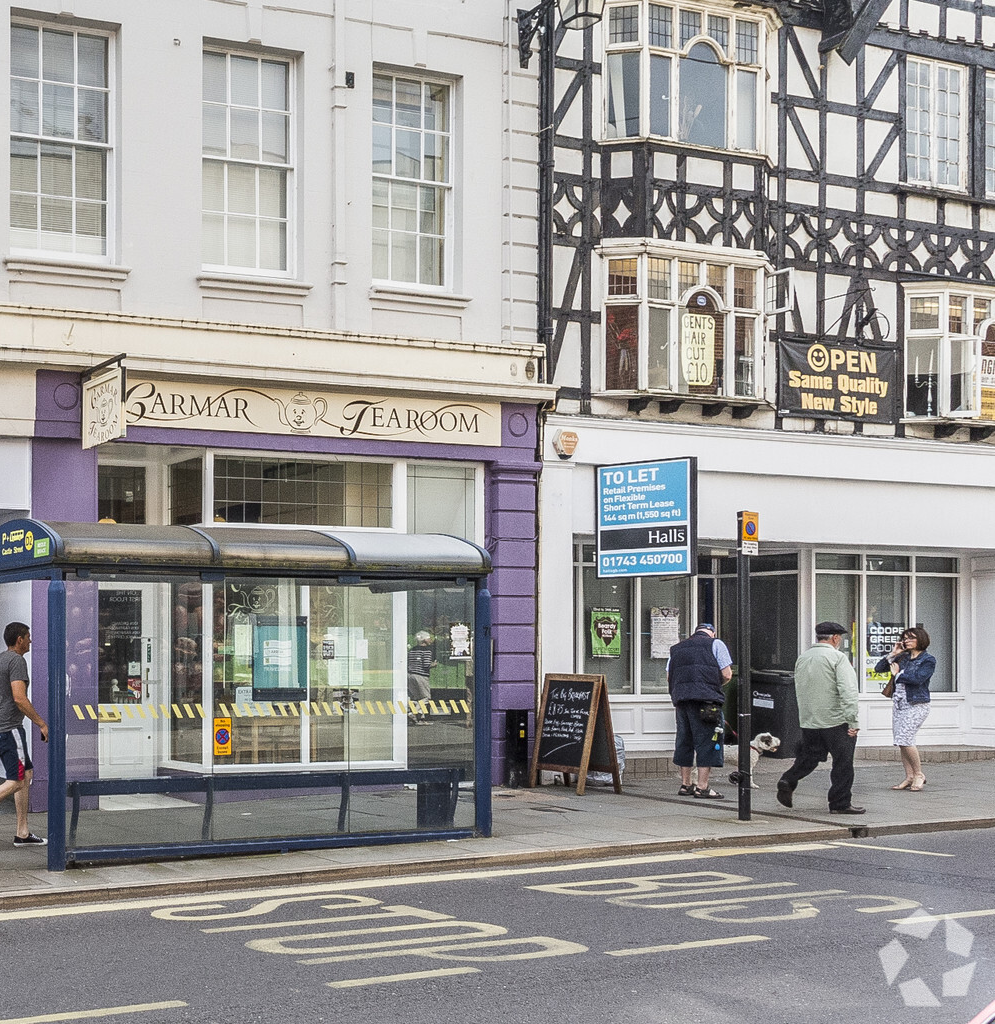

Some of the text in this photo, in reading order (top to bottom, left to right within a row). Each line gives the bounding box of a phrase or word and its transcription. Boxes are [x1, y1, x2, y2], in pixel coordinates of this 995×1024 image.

[684, 316, 713, 330] GENTS
[685, 331, 706, 345] HAIR
[687, 347, 705, 360] CUT
[807, 343, 877, 374] OPEN
[789, 370, 889, 398] Same Quality
[801, 393, 878, 416] New Style
[339, 397, 481, 437] TEAROOM
[603, 467, 660, 485] TO LET
[603, 483, 665, 495] Retail Premises
[614, 494, 645, 502] Flexible
[603, 500, 674, 512] Short Term Lease
[604, 513, 617, 521] 144
[661, 511, 670, 519] sq
[648, 528, 685, 543] Halls
[603, 555, 637, 567] 01743
[639, 553, 683, 565] 450700
[524, 871, 923, 924] BUS
